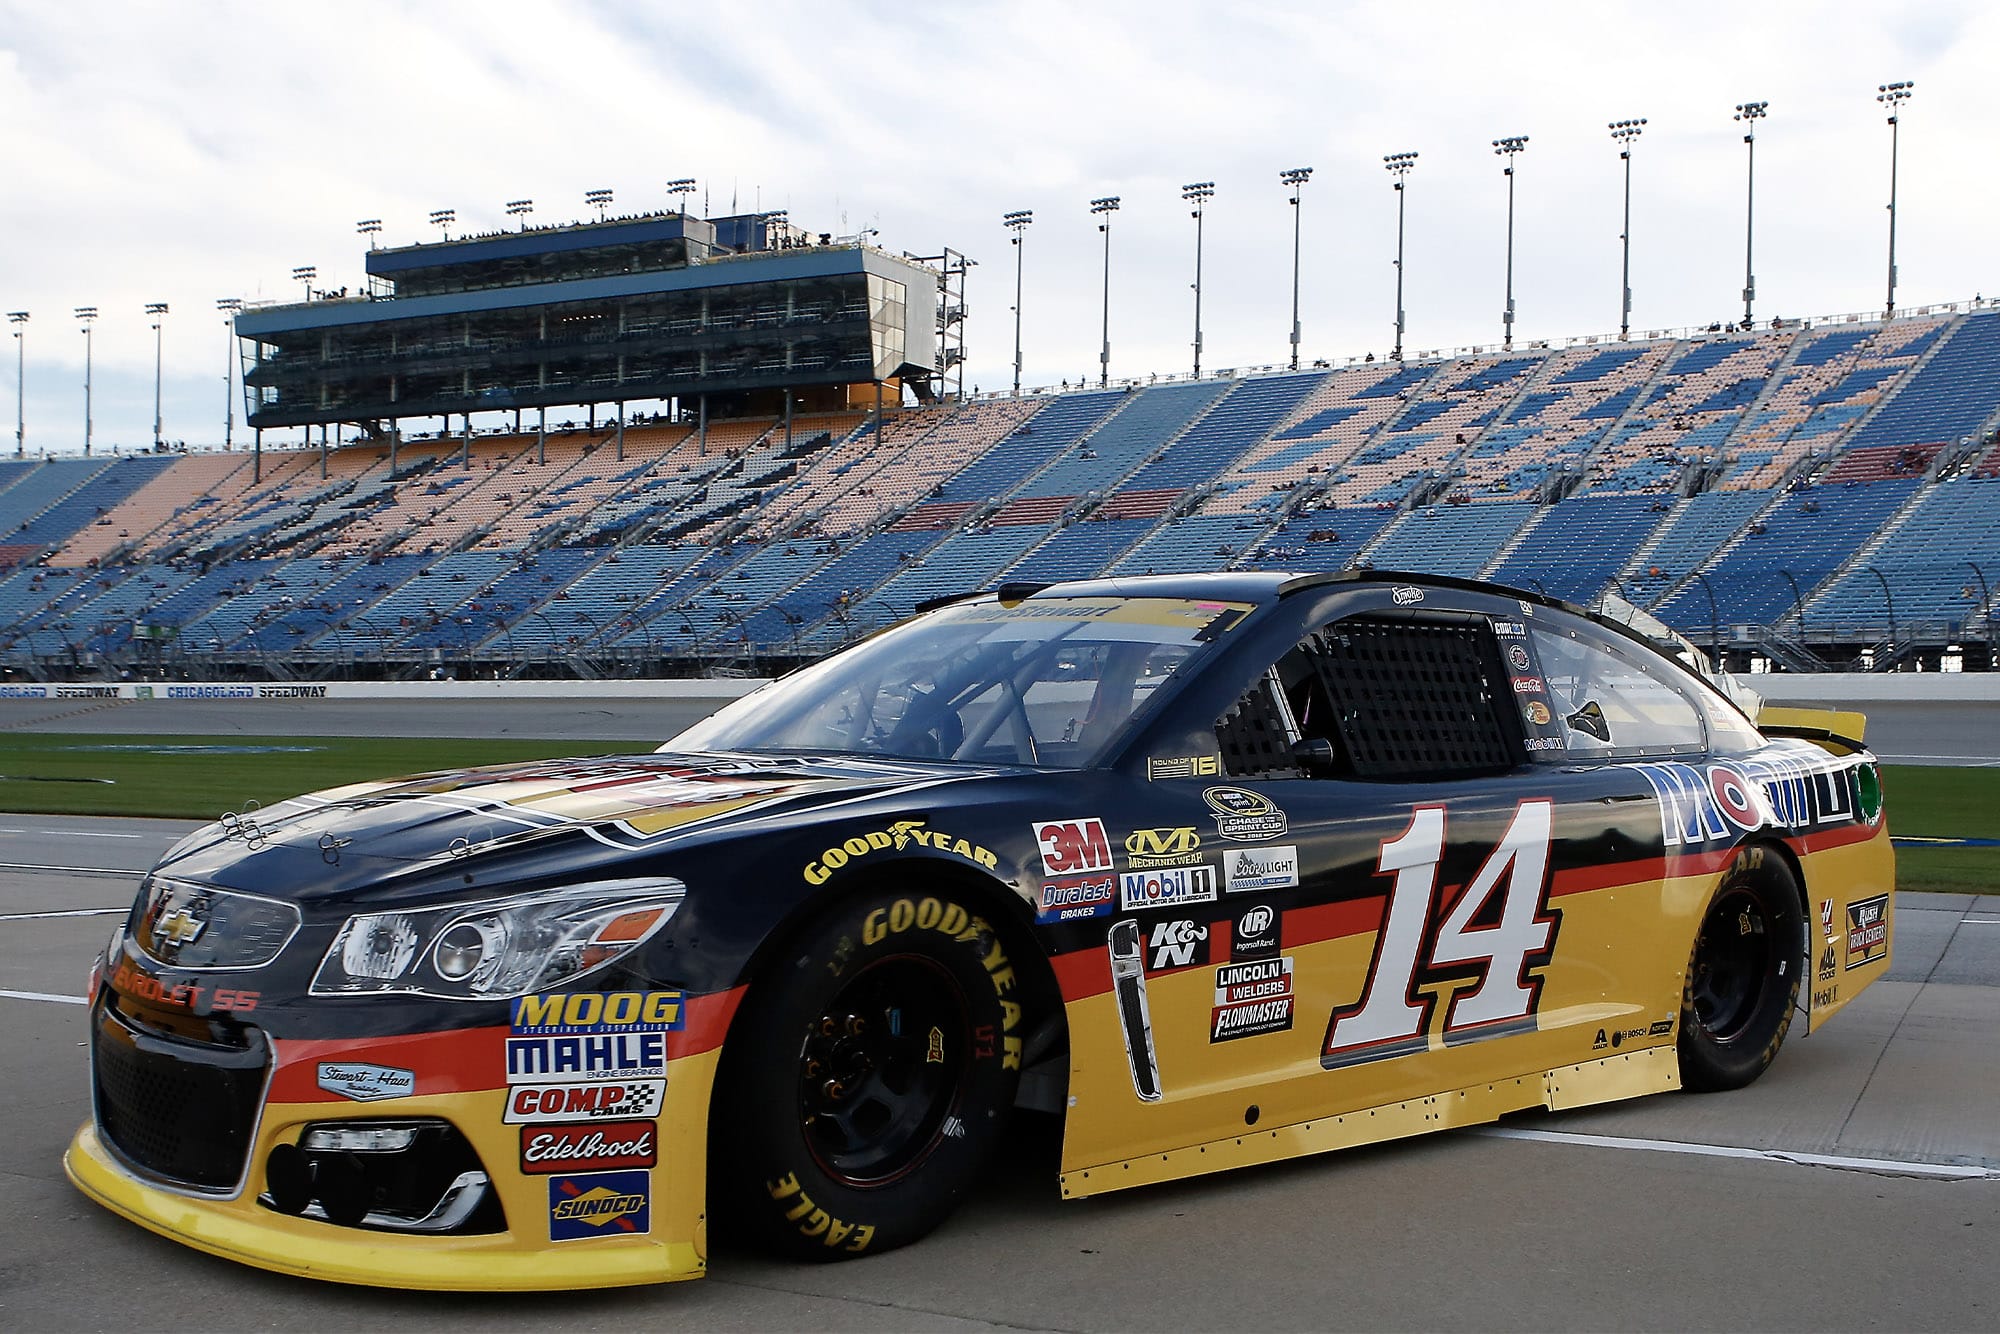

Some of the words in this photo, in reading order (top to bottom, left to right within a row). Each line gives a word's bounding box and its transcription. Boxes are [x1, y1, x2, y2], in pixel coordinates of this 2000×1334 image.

[56, 687, 120, 698] SPEEDWAY
[168, 687, 254, 698] CHICAGOLAND
[260, 687, 327, 698] SPEEDWAY
[1523, 738, 1554, 751] Mobil
[1153, 758, 1179, 766] ROUND
[1190, 756, 1217, 776] 16
[1225, 823, 1260, 832] SPRINT
[1262, 822, 1282, 830] CUP
[1229, 816, 1266, 825] CHASE
[1039, 820, 1111, 872] 3M
[1128, 855, 1177, 869] MECHANIX
[1176, 851, 1204, 866] WEAR
[1235, 859, 1266, 876] Coors
[1266, 860, 1293, 873] LIGHT
[1042, 879, 1113, 907] Duralast
[1126, 871, 1186, 901] Mobil
[1060, 907, 1095, 920] BRAKES
[1244, 911, 1268, 933] IR
[1858, 905, 1878, 928] RUSH
[1327, 798, 1555, 1055] 14
[1236, 940, 1260, 951] Ingersoll
[1220, 962, 1280, 986] LINCOLN
[1818, 969, 1836, 981] TOOLS
[211, 989, 261, 1012] SS
[1233, 981, 1285, 1000] WELDERS
[515, 991, 682, 1027] MOOG
[1215, 1000, 1288, 1038] FLOWMASTER
[523, 1026, 578, 1034] STEERING
[600, 1023, 670, 1033] SUSPENSION
[1628, 1028, 1647, 1038] BOSCH
[508, 1034, 663, 1075] MAHLE
[586, 1070, 619, 1079] ENGINE
[619, 1067, 663, 1077] BEARINGS
[513, 1086, 625, 1115] COMP
[589, 1104, 645, 1117] CAMS
[525, 1132, 652, 1162] Edelbrock
[557, 1195, 642, 1218] SUNOCO
[767, 1170, 876, 1253] EAGLE
